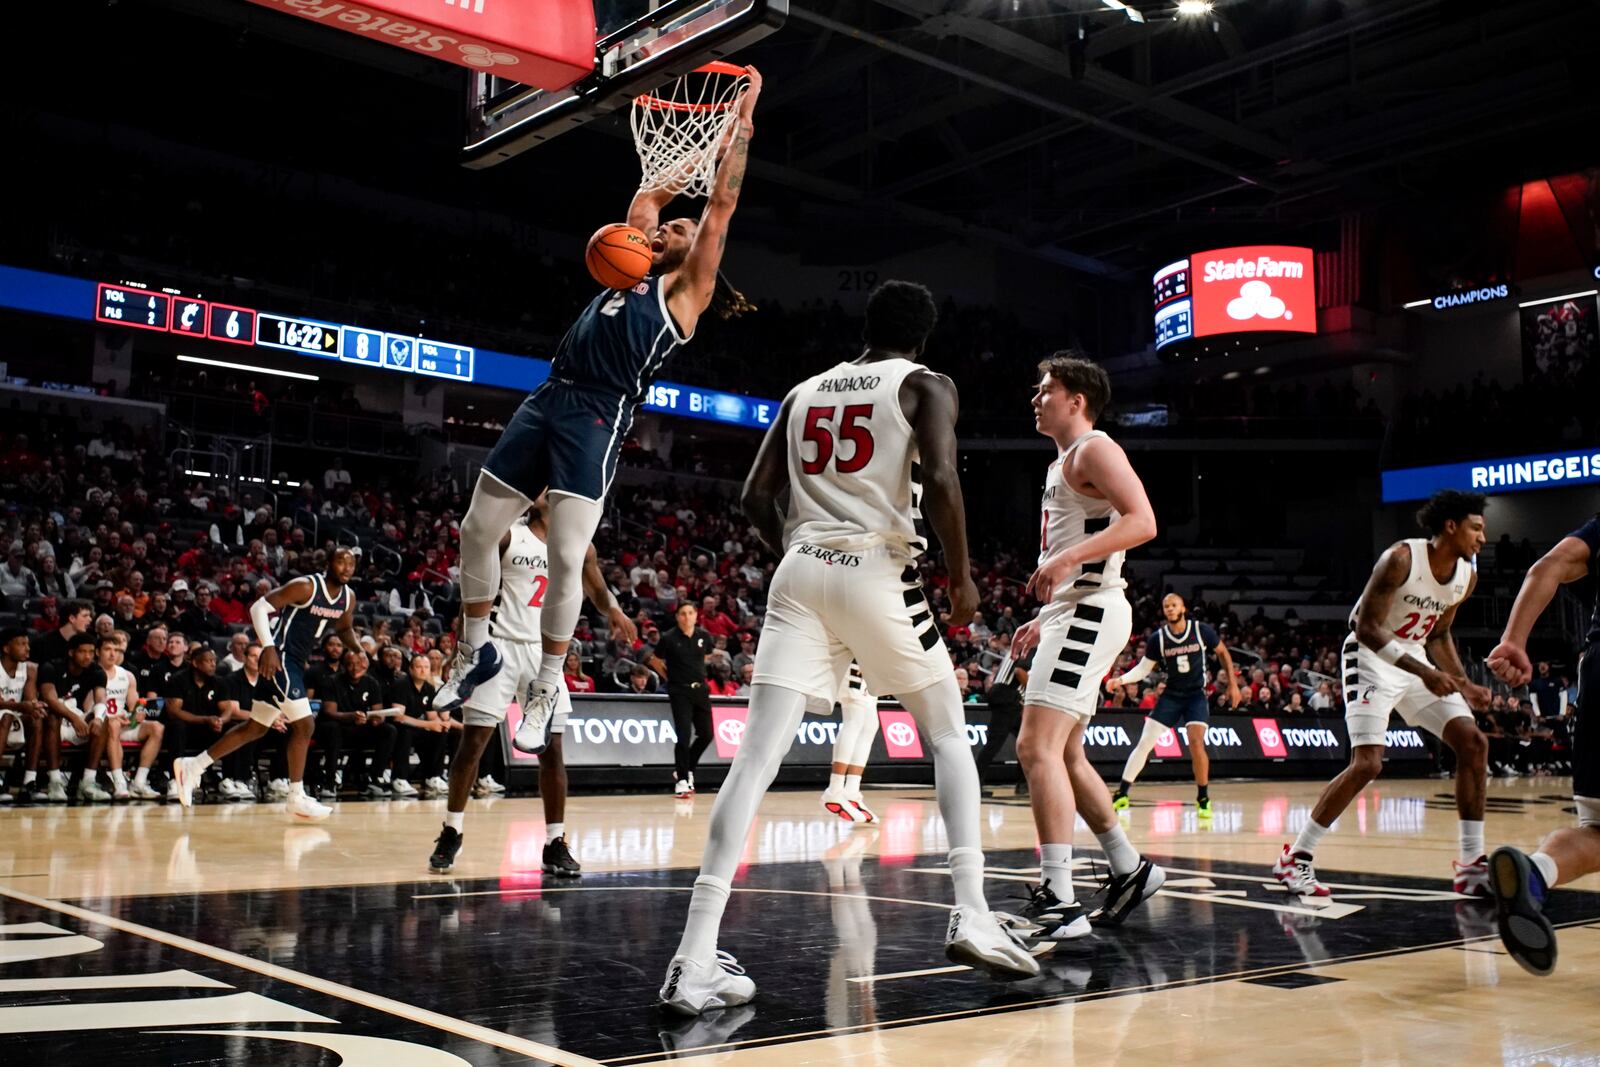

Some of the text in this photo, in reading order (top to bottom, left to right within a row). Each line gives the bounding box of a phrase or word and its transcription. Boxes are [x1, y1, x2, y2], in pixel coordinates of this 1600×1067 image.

[838, 270, 878, 291] 219
[1434, 284, 1508, 309] CHAMPIONS
[225, 310, 240, 338] 6
[277, 321, 323, 351] 16:22
[356, 333, 370, 359] 8
[816, 375, 881, 393] BANDAOGO
[646, 385, 681, 409] IST
[801, 403, 875, 475] 55
[796, 543, 864, 568] BEARCATS
[314, 618, 328, 638] 1
[1393, 611, 1438, 641] 23
[1176, 654, 1191, 674] 5
[566, 717, 678, 744] TOYOTA
[1281, 728, 1340, 748] TOYOTA
